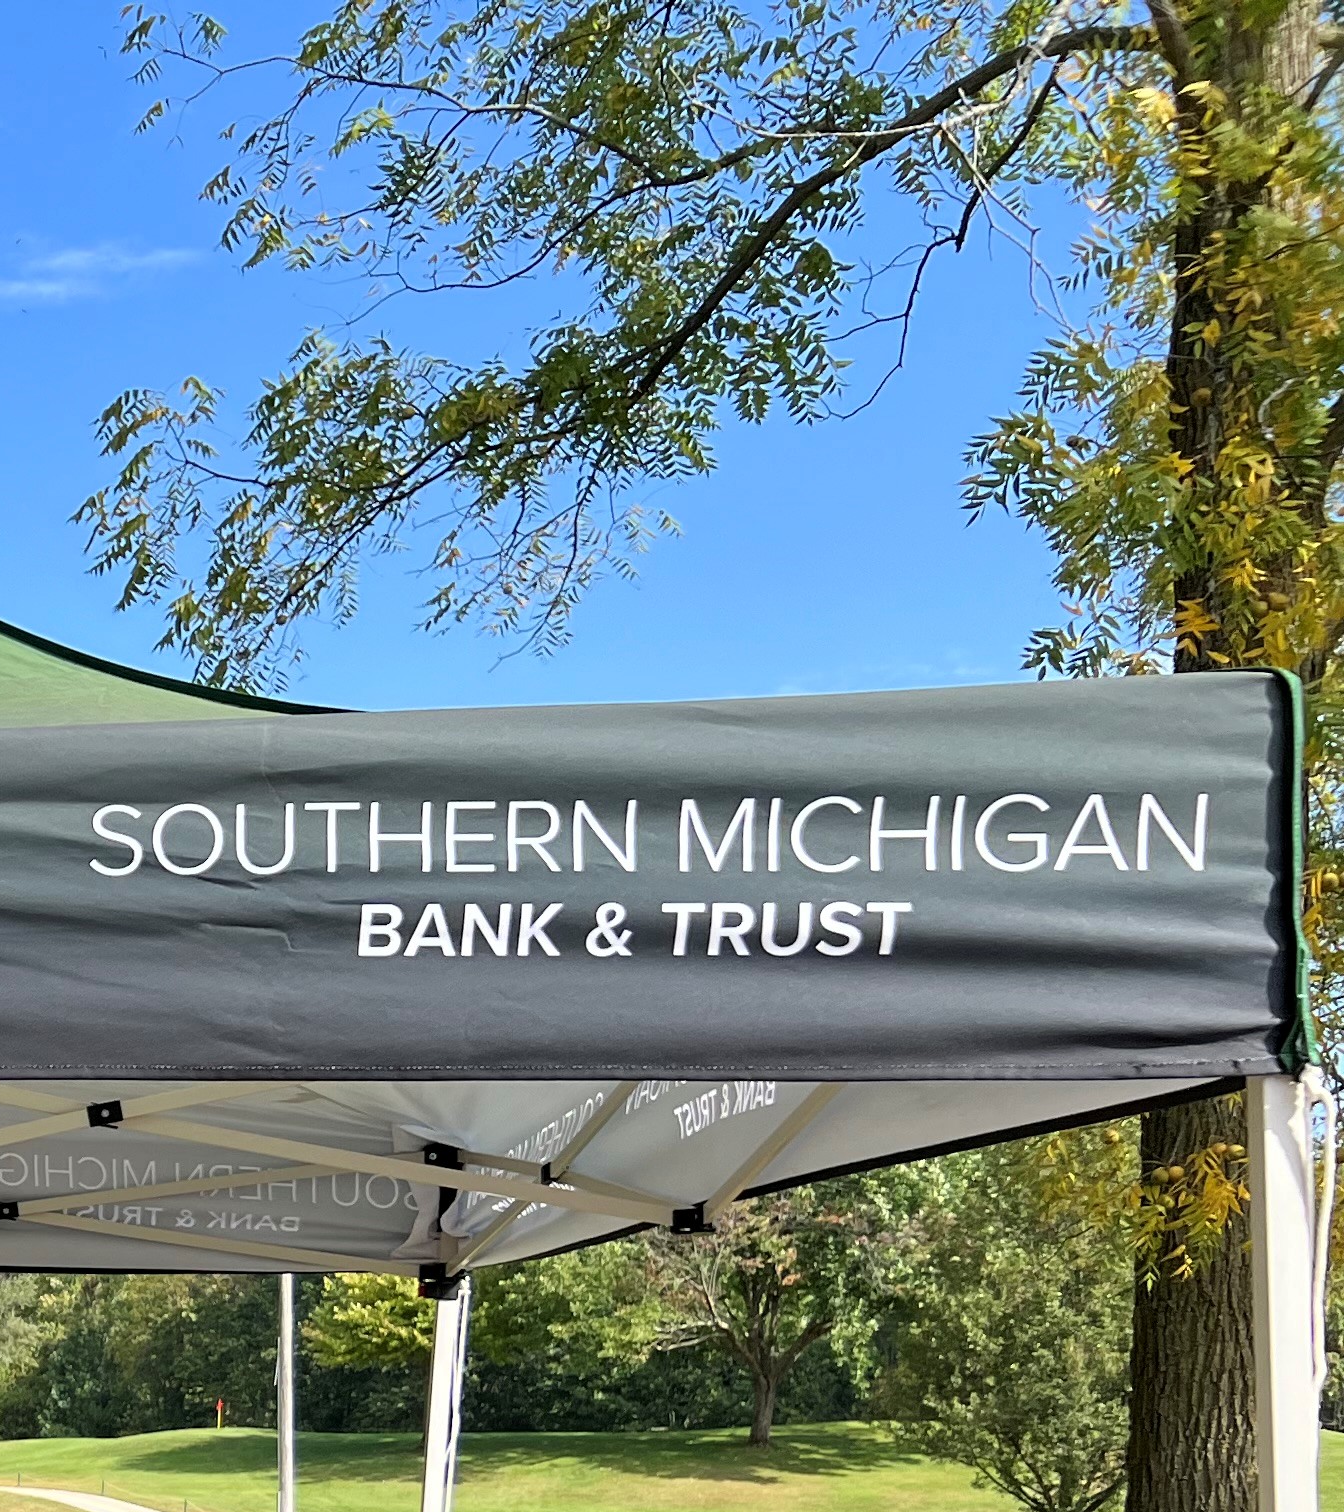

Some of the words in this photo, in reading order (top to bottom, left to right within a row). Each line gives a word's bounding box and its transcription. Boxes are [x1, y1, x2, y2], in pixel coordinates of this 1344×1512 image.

[88, 798, 638, 877] SOUTHERN
[676, 791, 1211, 874] MICHIGAN
[355, 901, 563, 959] BANK
[584, 902, 633, 957] &
[662, 901, 913, 957] TRUST
